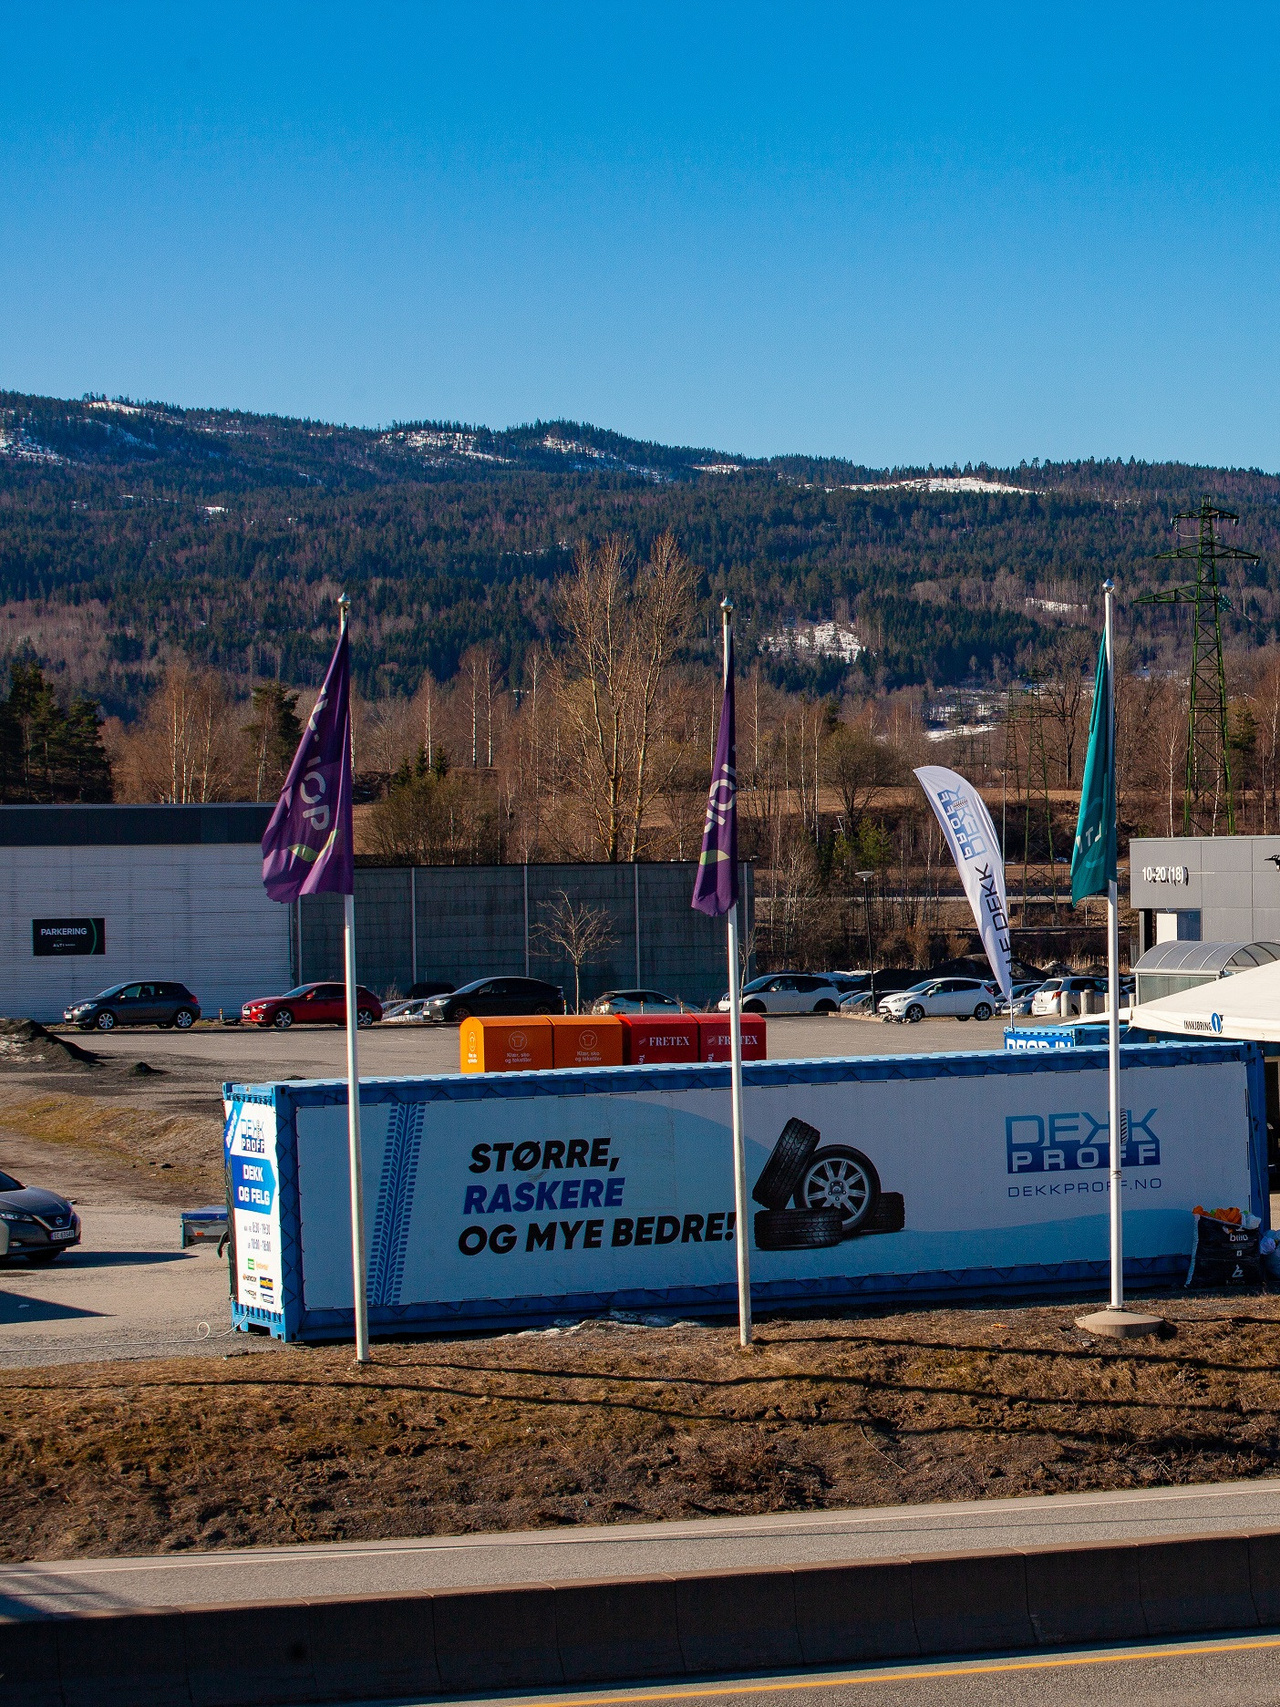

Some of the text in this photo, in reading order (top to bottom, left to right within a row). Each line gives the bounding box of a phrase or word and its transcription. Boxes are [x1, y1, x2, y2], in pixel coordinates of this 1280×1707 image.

[40, 928, 88, 936] PARKERING
[649, 1036, 690, 1047] FRETEX
[718, 1035, 758, 1045] FRTEX
[468, 1137, 621, 1174] STØRRE,
[243, 1164, 264, 1182] DEKK
[238, 1186, 270, 1206] OG FELG
[462, 1177, 626, 1215] RASKERE
[458, 1211, 737, 1256] OG MYE BEDRE!
